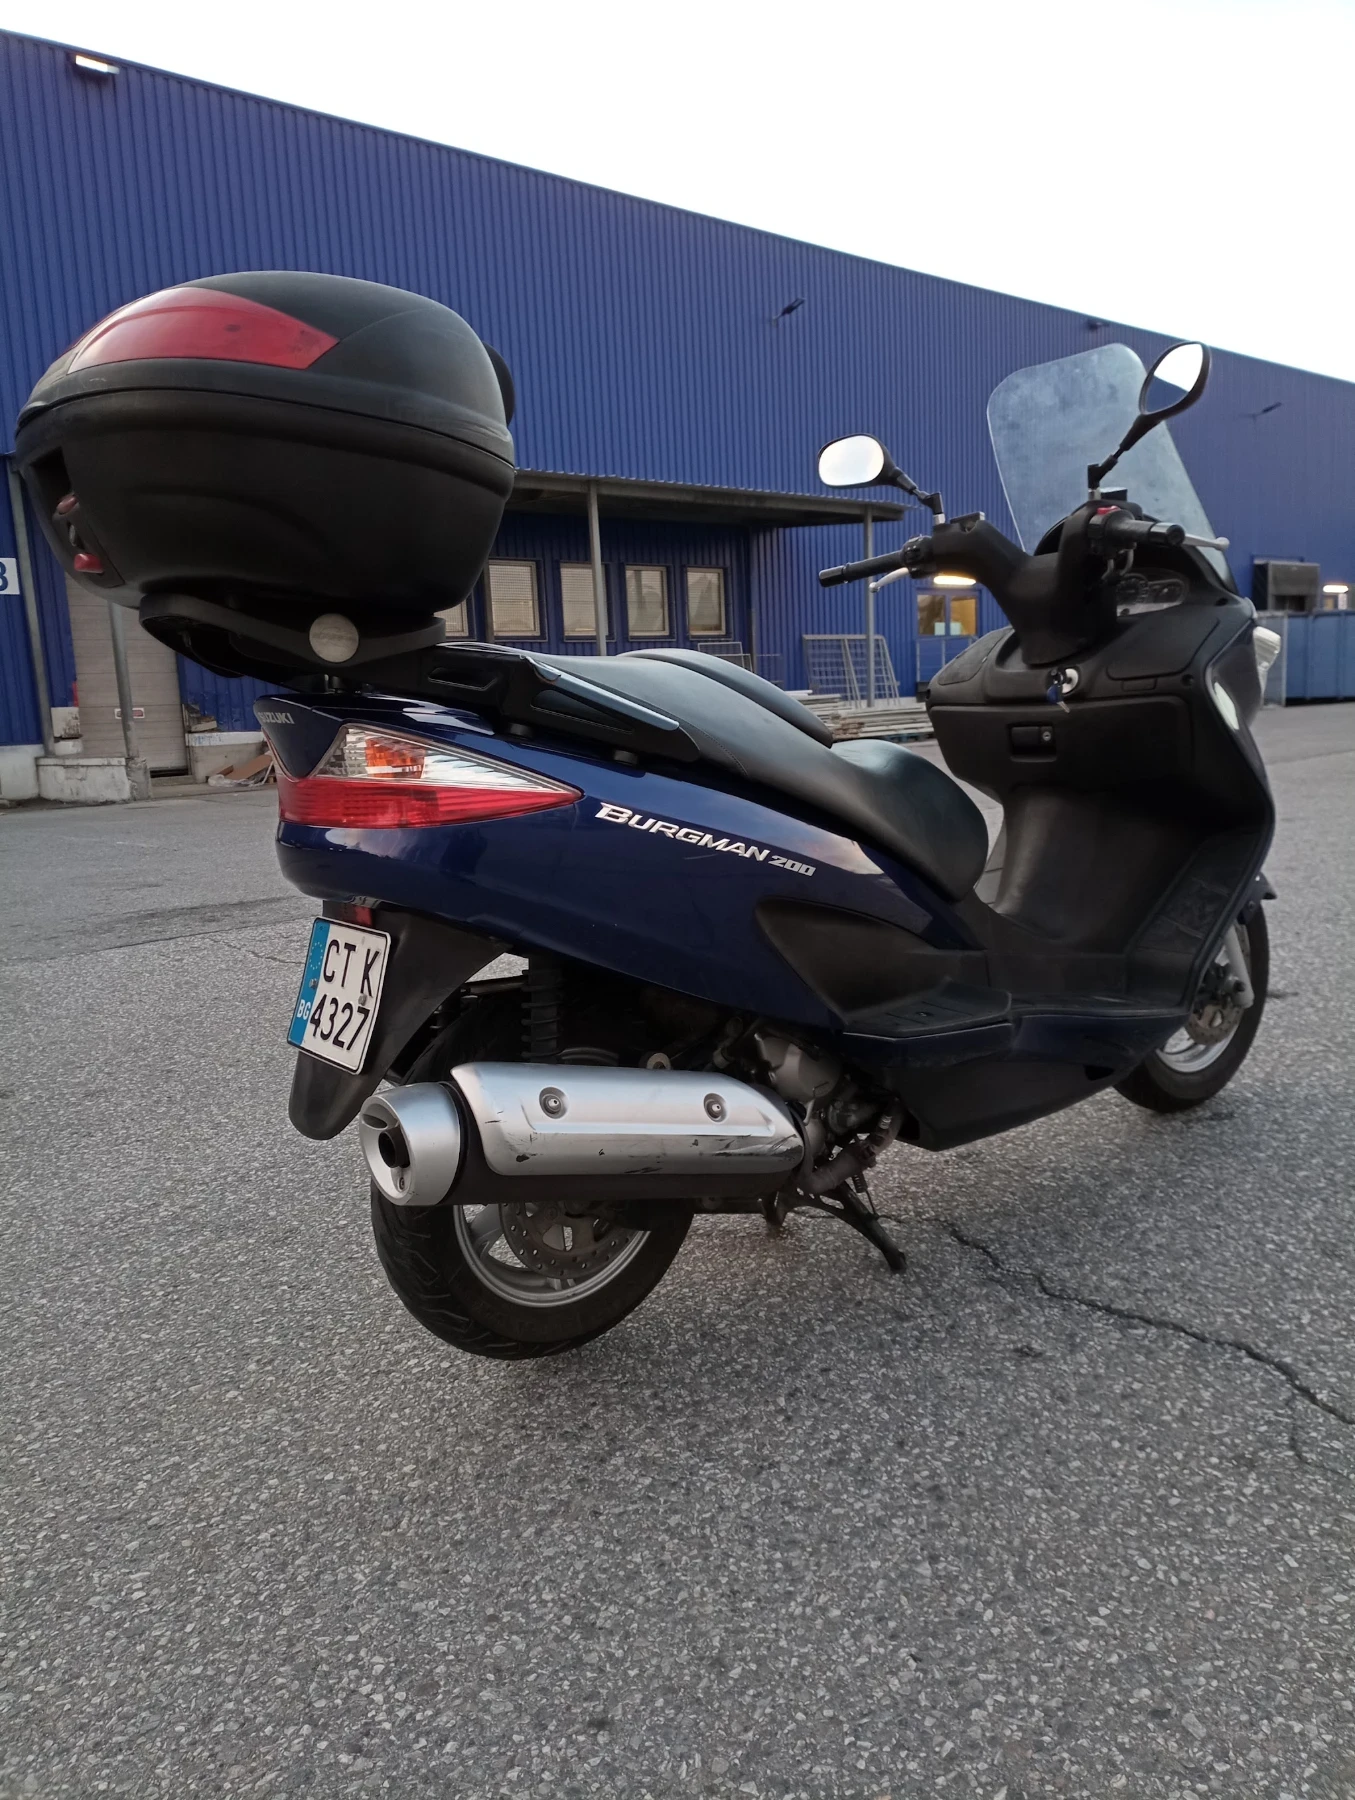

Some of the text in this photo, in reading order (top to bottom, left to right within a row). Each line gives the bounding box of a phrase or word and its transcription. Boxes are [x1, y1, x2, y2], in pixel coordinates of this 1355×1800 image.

[257, 711, 295, 725] SUZUKI
[595, 802, 817, 877] BURGMAN 200
[296, 999, 312, 1021] BG
[309, 993, 371, 1051] 4327
